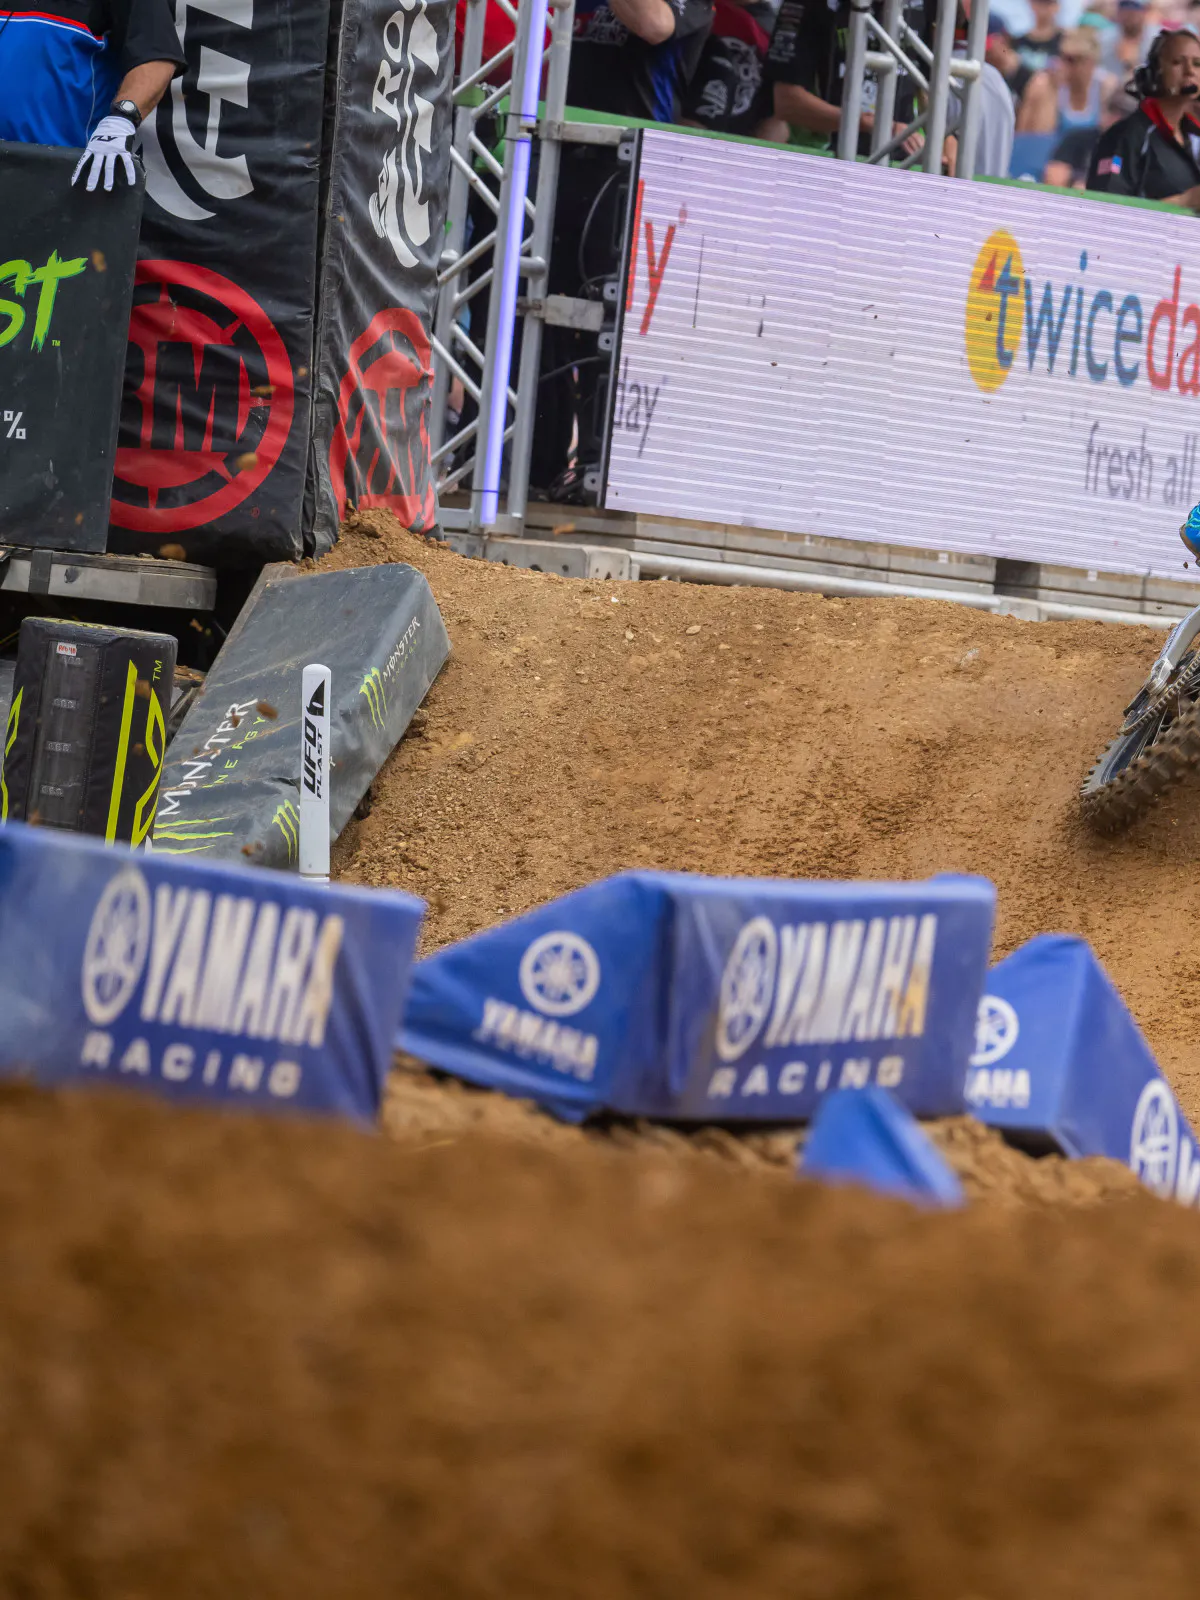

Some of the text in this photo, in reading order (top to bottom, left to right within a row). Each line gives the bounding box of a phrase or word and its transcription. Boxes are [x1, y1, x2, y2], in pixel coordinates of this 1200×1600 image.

[1085, 419, 1153, 501] fresh
[1163, 434, 1198, 506] all
[152, 659, 163, 682] TM
[383, 616, 421, 682] MONSTER
[303, 716, 318, 795] UFO
[315, 733, 323, 799] PLAST
[140, 882, 345, 1049] YAMAHA
[764, 913, 938, 1050] YAMAHA
[80, 1030, 302, 1098] RACING
[707, 1055, 905, 1099] RACING
